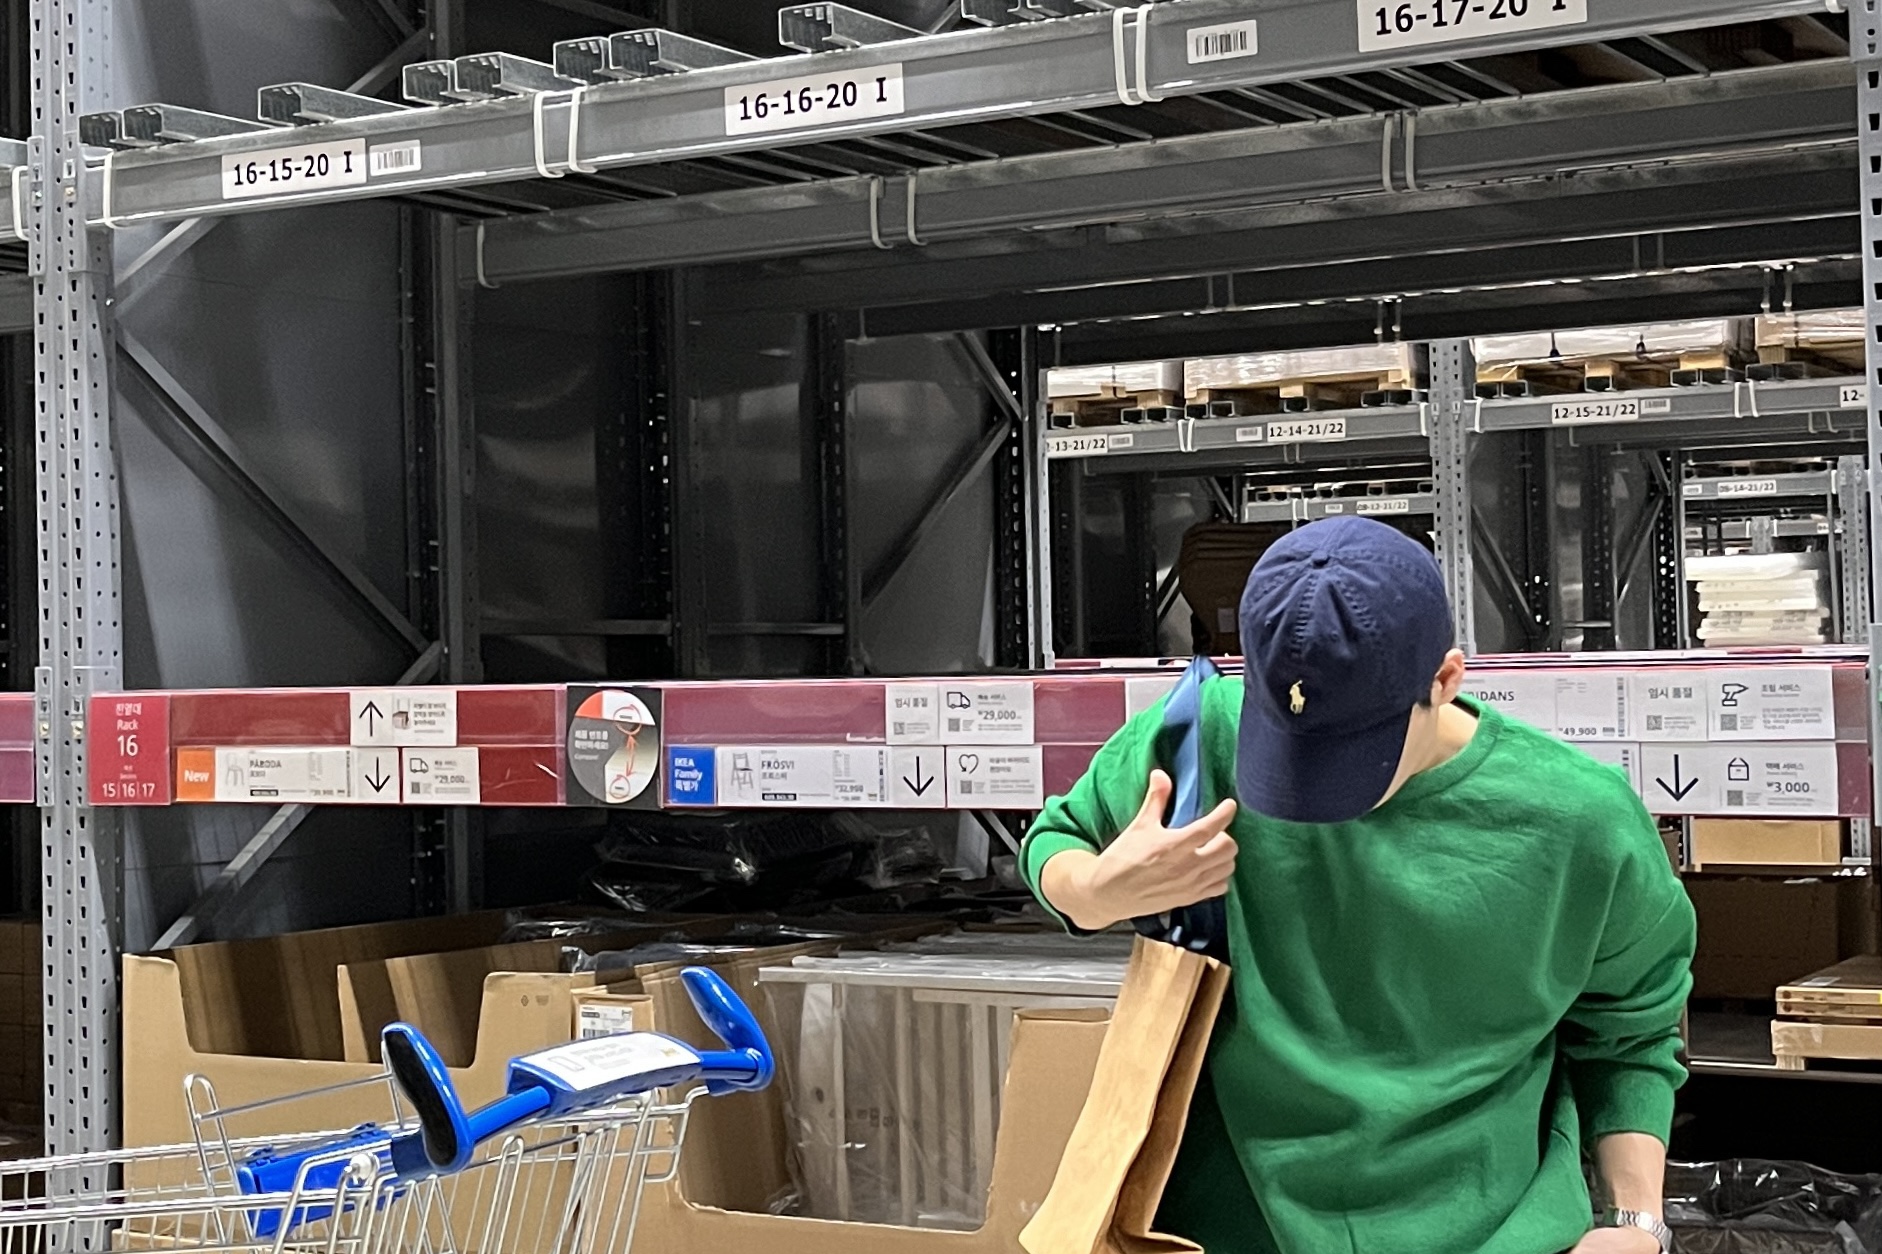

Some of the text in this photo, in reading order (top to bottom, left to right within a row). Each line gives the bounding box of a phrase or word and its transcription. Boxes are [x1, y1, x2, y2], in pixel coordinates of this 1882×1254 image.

[1375, 0, 1528, 36] 16-17-20
[739, 81, 857, 121] 16-16-20
[233, 153, 329, 185] 16-15-20
[1553, 403, 1636, 419] 12-15-21/22
[1269, 422, 1344, 438] 12-14-21/22
[116, 719, 138, 731] Rack
[117, 734, 139, 757] 16
[674, 757, 696, 768] IKEA
[184, 770, 210, 783] New
[674, 769, 704, 781] Family
[102, 782, 156, 798] 15 16 17
